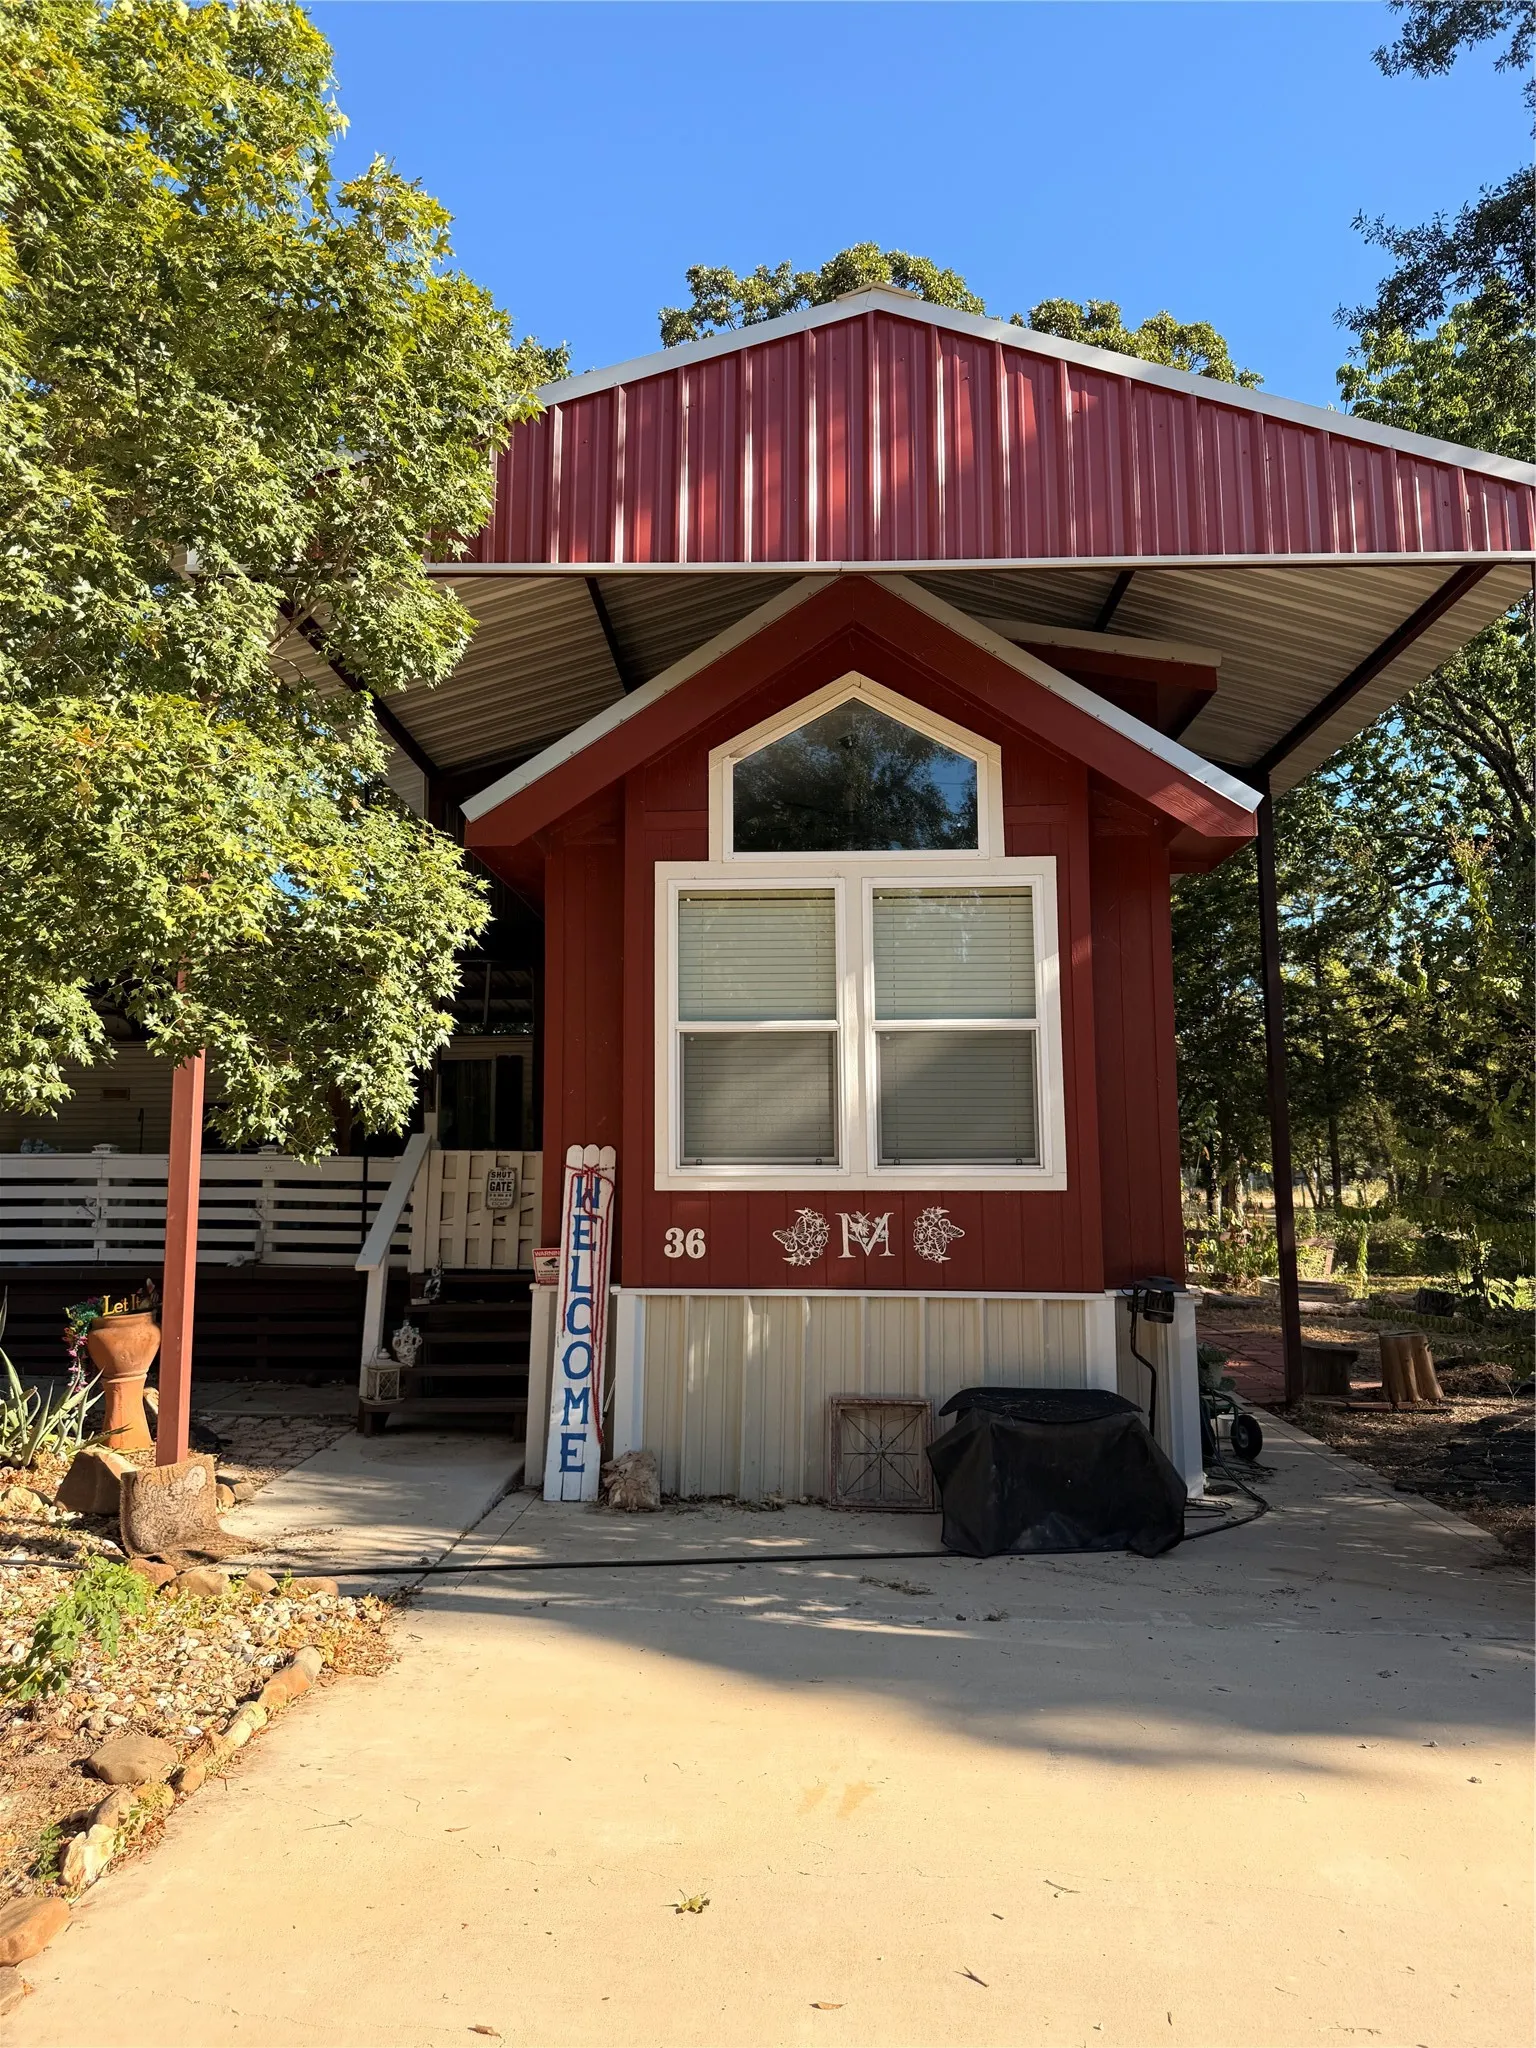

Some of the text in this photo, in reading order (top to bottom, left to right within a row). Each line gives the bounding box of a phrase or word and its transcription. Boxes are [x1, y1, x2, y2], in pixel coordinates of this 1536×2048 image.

[490, 1181, 512, 1191] GATE
[664, 1212, 895, 1259] 36 M
[103, 1295, 128, 1316] Let
[559, 1176, 600, 1472] WELCOME
